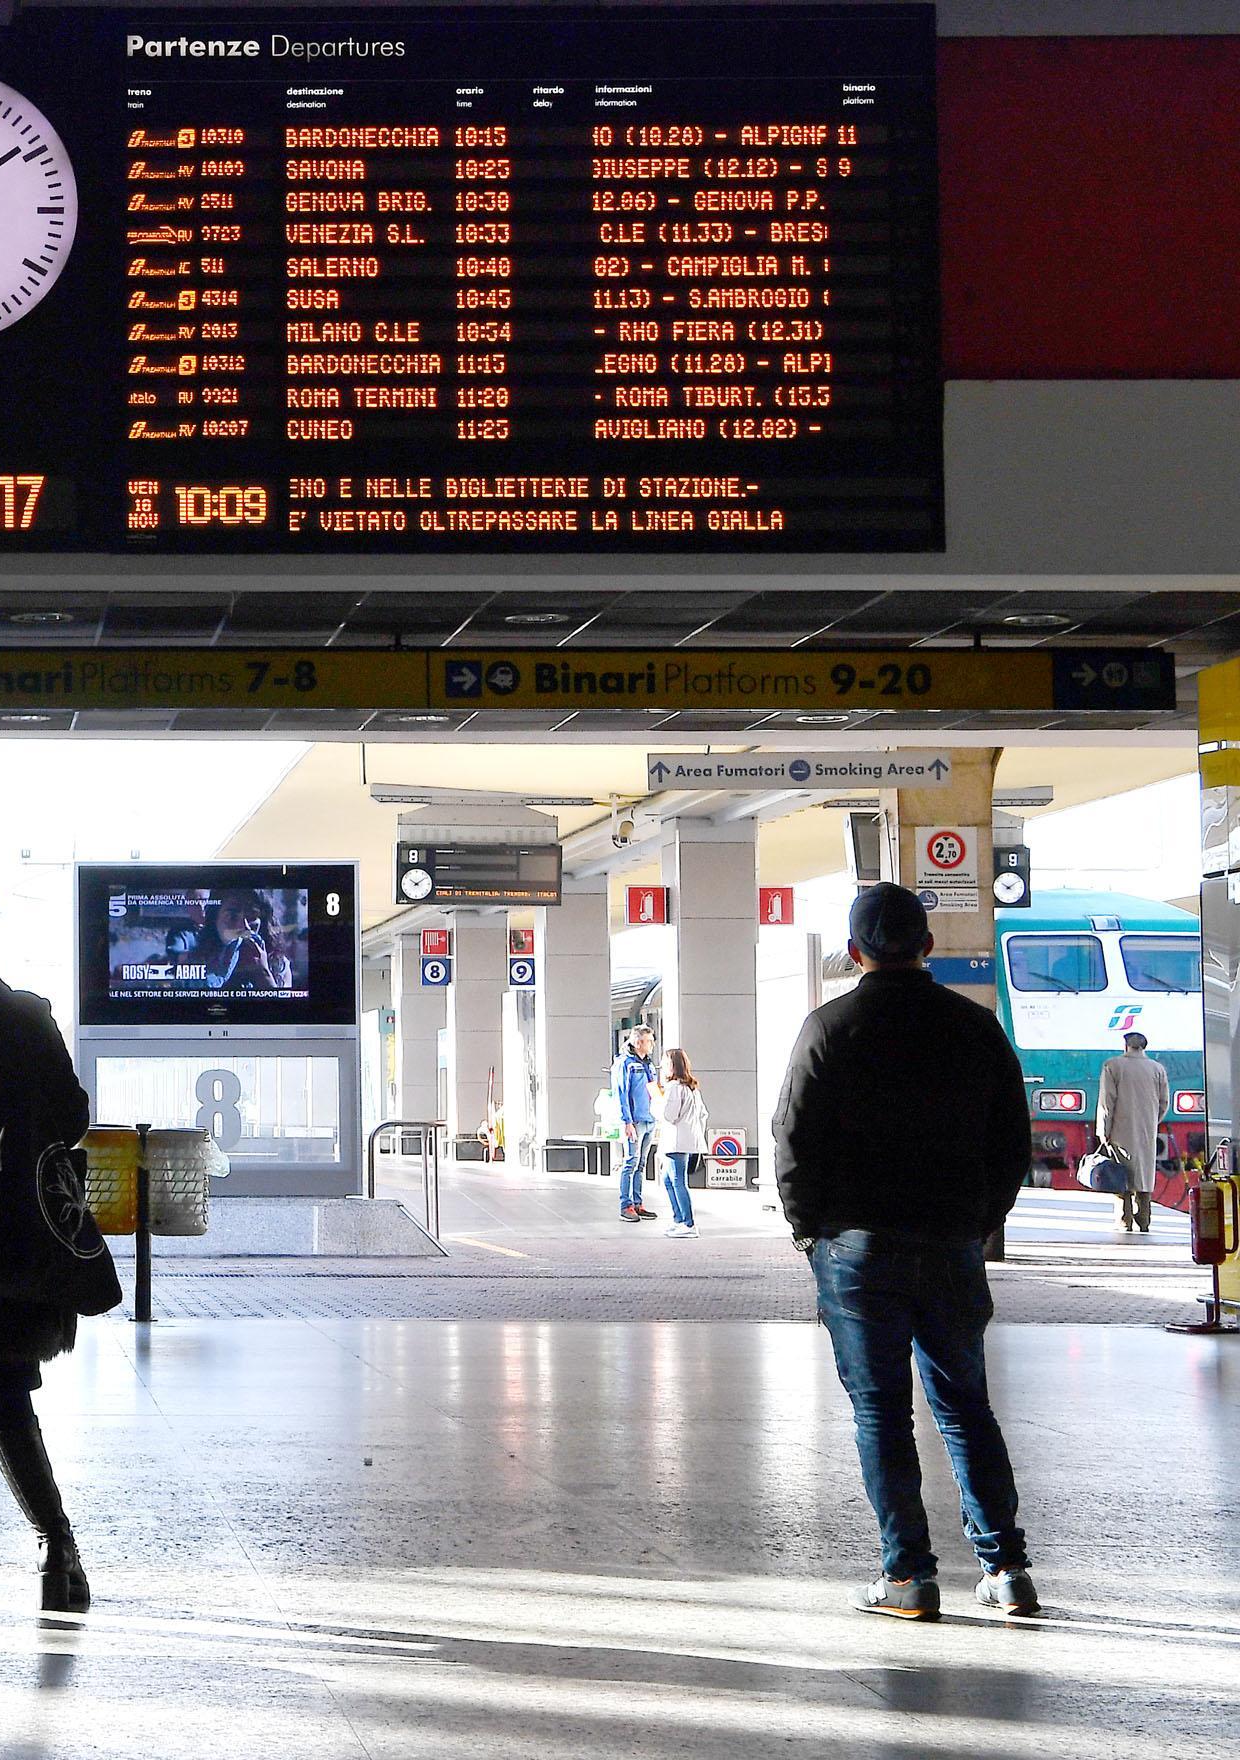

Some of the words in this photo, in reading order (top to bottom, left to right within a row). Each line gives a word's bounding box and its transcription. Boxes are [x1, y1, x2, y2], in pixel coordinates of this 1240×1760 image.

[128, 36, 260, 56] Partenze
[271, 34, 406, 62] Departures
[127, 88, 152, 96] treno
[286, 87, 344, 96] destinazione
[455, 86, 484, 95] orario
[532, 85, 565, 94] ritardo
[595, 84, 653, 94] informazioni
[842, 83, 876, 92] binario
[286, 100, 327, 109] destination
[456, 100, 473, 108] time
[532, 98, 553, 108] delay
[594, 98, 638, 107] information
[842, 96, 875, 106] platform
[286, 126, 441, 147] BARDONECCHIA
[455, 126, 506, 146] 10:15
[286, 160, 366, 180] SAVONA
[456, 158, 511, 179] 10:25
[286, 223, 375, 245] VENEZIA
[388, 224, 424, 244] S.L.
[456, 223, 511, 243] 10:33
[287, 256, 380, 278] SALERNO
[457, 256, 512, 277] 10:40
[620, 321, 661, 341] RHO
[671, 320, 736, 341] FIERA
[749, 320, 823, 341] (12.31)
[595, 418, 707, 439] AVIGLIANO
[720, 418, 798, 438] (12.02)
[367, 478, 431, 498] NELLE
[446, 478, 589, 498] BIGLIETTERIE
[604, 478, 626, 497] DI
[80, 661, 232, 693] Platforms
[245, 661, 317, 691] 7-8
[534, 660, 656, 694] Binari
[664, 660, 816, 694] Platforms
[830, 661, 932, 695] 9-20
[675, 765, 713, 777] Area
[717, 764, 785, 777] Fumatori
[815, 763, 883, 778] Smoking
[887, 764, 925, 776] Area
[408, 850, 419, 863] 8
[1009, 854, 1017, 866] 9
[327, 893, 339, 915] 8
[122, 965, 150, 980] ROSY
[176, 965, 207, 980] ABATE
[430, 965, 440, 978] 8
[516, 966, 527, 978] 9
[196, 1069, 242, 1151] 8
